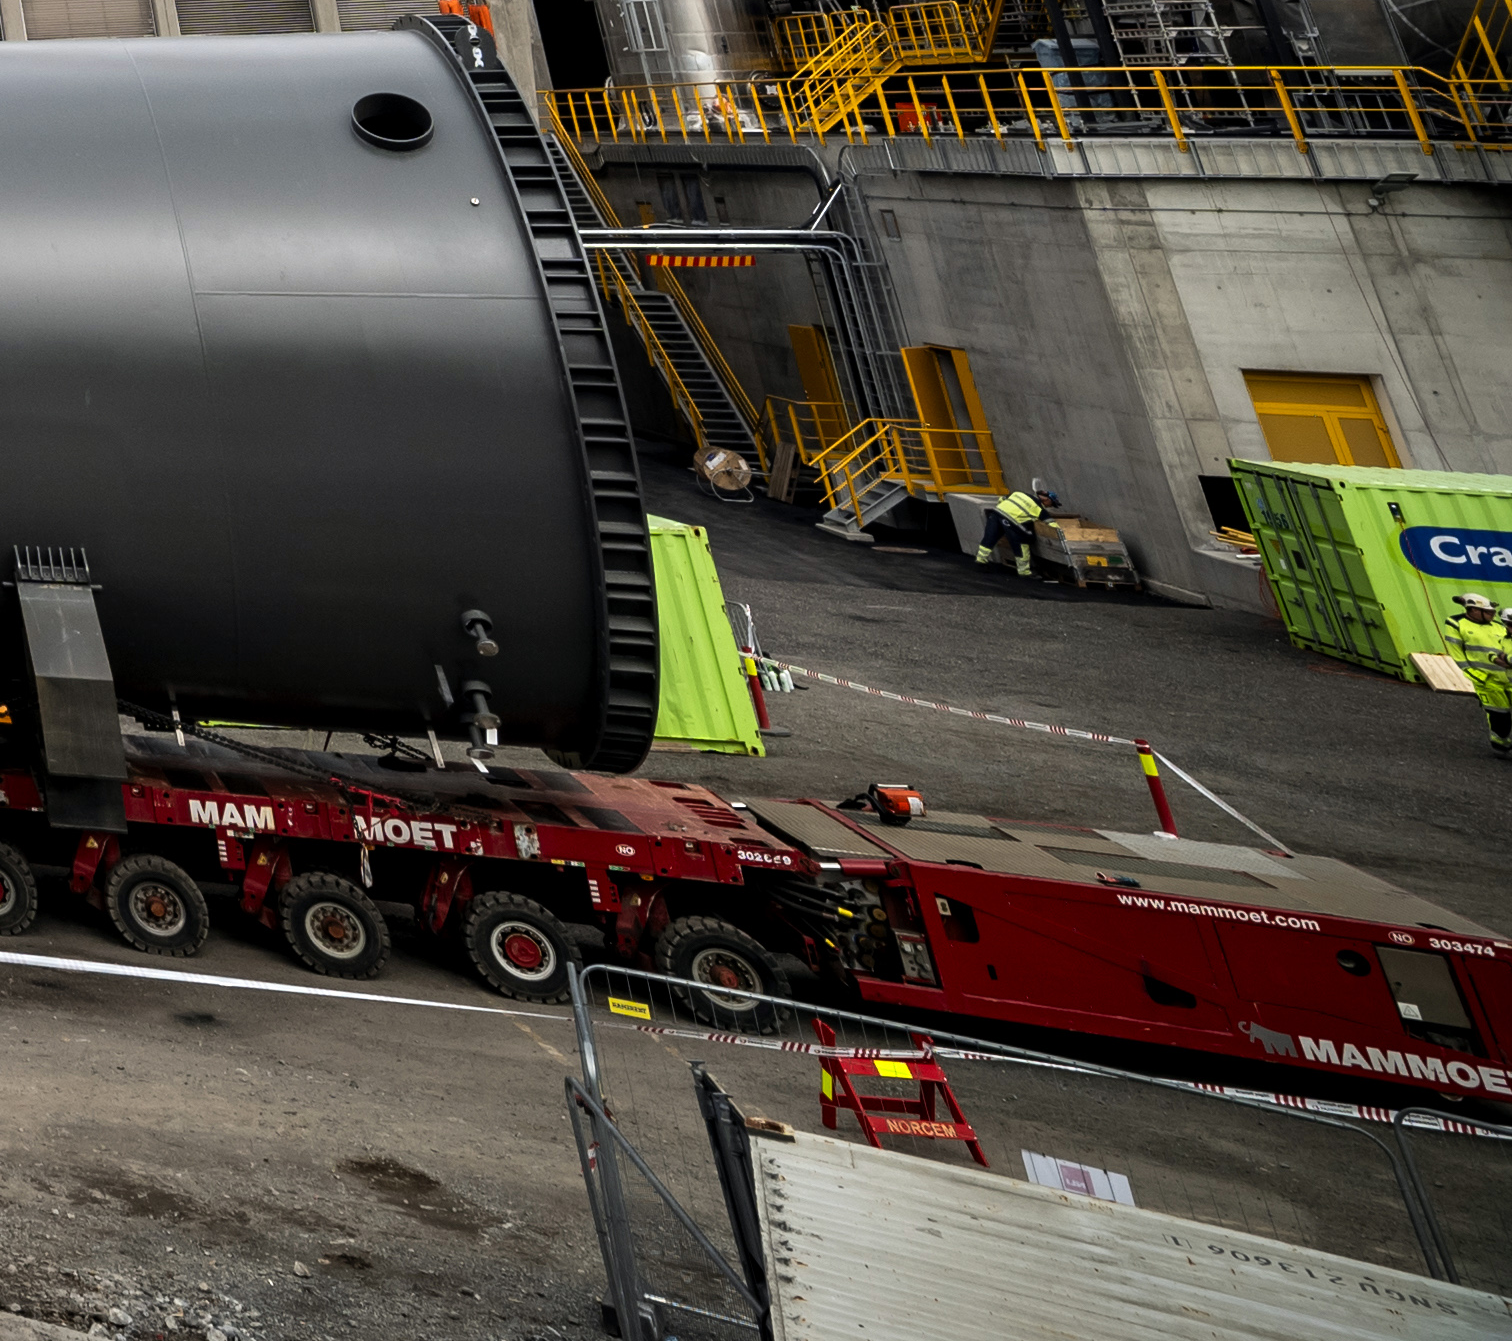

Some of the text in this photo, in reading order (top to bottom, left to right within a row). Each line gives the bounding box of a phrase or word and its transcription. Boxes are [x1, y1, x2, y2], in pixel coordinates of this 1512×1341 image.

[1429, 534, 1512, 567] Cra
[188, 799, 457, 850] MAM MOET
[618, 845, 634, 856] NO
[1116, 893, 1321, 931] www.mammoet.com
[1391, 932, 1414, 945] NO
[1428, 937, 1495, 958] 303474
[1298, 1035, 1512, 1096] MAMMOE
[886, 1118, 958, 1138] NORCEM
[1206, 1242, 1346, 1288] 213606
[1358, 1281, 1459, 1317] SNGU
